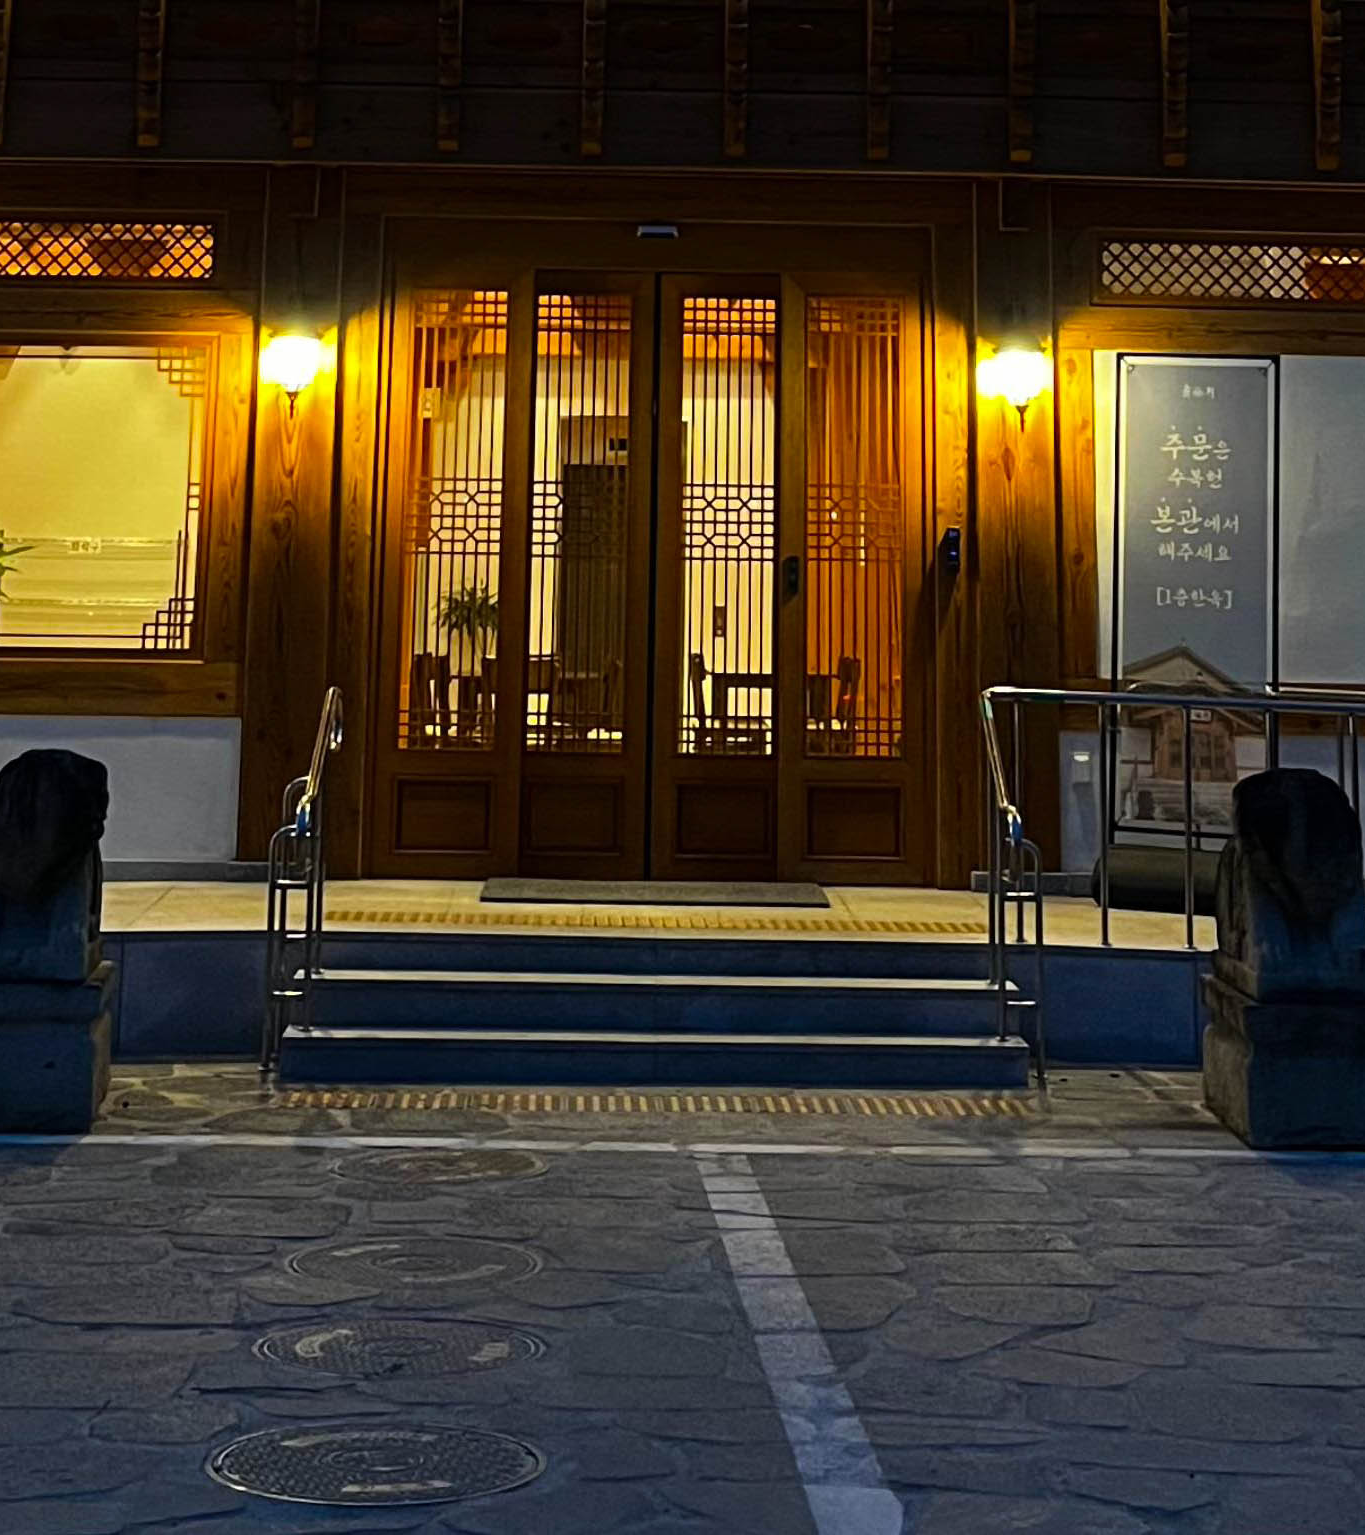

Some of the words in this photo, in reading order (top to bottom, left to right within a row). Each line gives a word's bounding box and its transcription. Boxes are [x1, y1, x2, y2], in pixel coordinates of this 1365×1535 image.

[1160, 431, 1232, 461] 주문은
[1150, 504, 1240, 535] 본관에서
[1157, 540, 1233, 562] 해주세요
